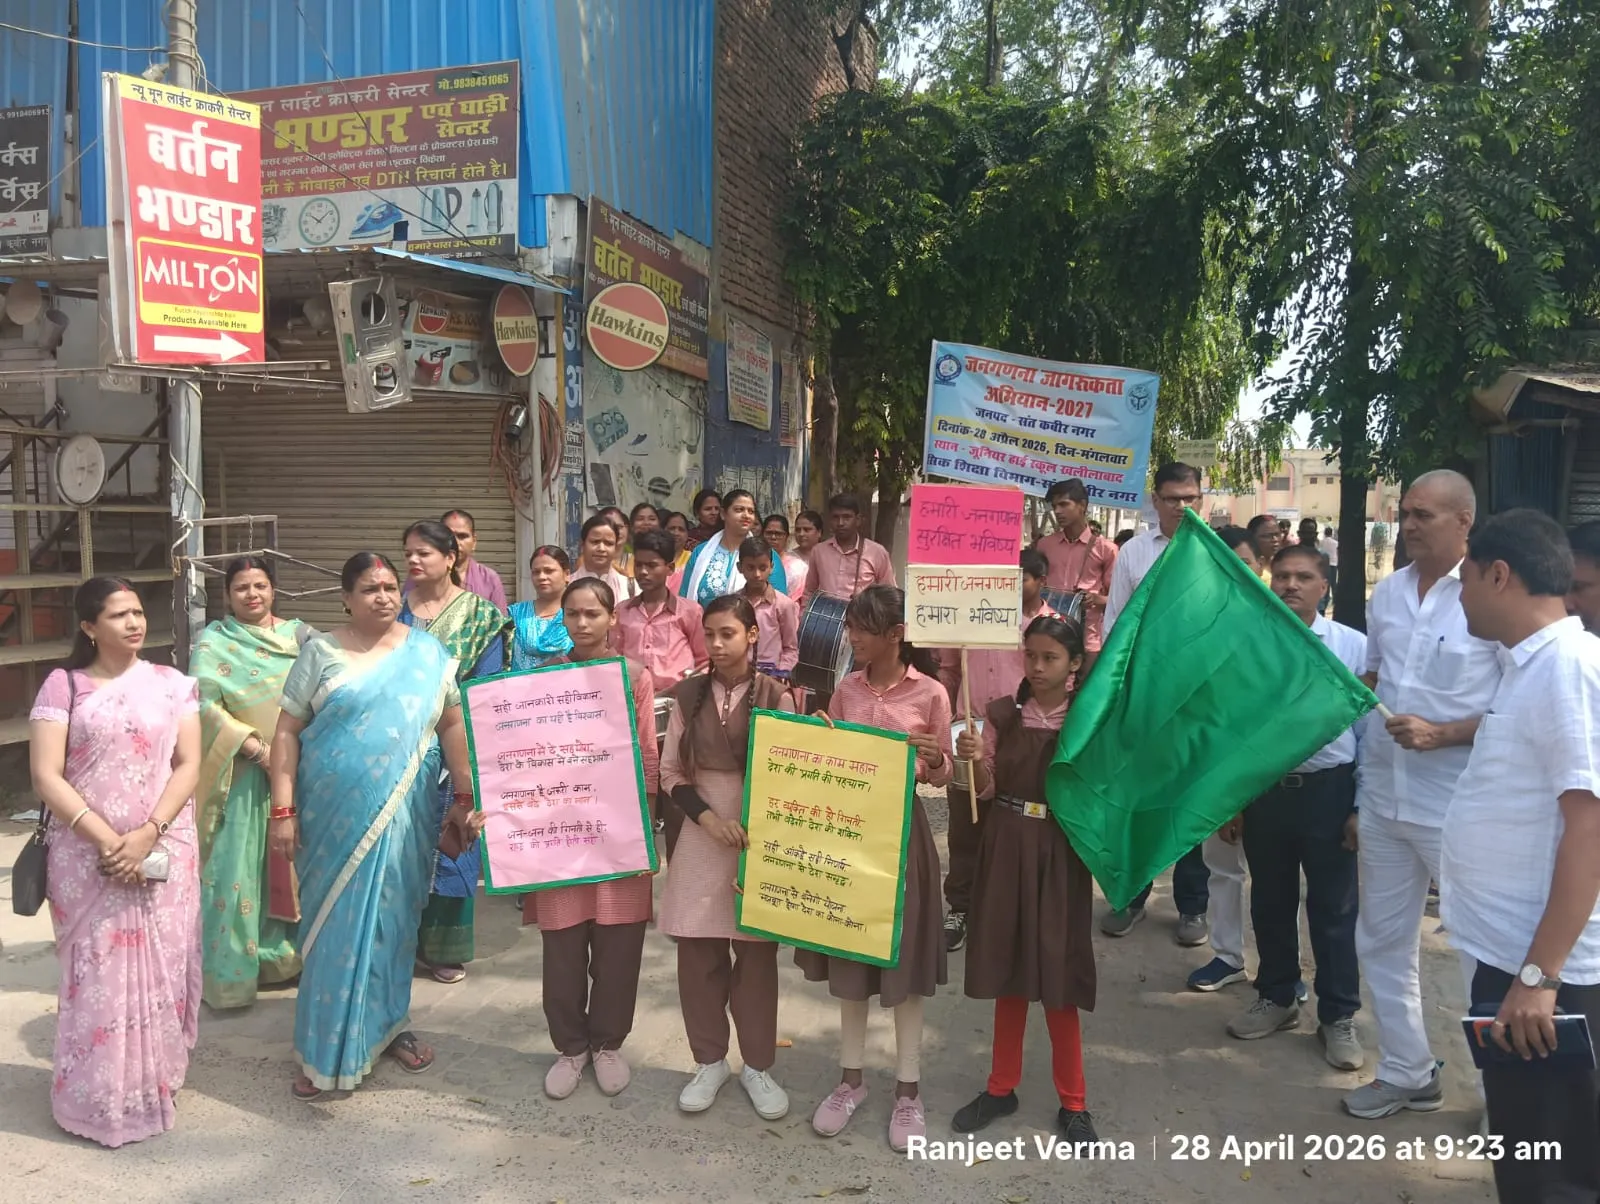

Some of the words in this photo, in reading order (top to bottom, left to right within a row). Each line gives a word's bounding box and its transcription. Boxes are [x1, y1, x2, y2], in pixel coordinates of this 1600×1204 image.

[131, 84, 145, 101] न्यू
[147, 88, 163, 104] मून
[166, 91, 192, 109] लाईट
[195, 98, 224, 115] क्राकरी
[280, 91, 323, 111] लाईट
[328, 87, 381, 107] क्राकरी
[387, 82, 431, 100] सेन्टर
[419, 97, 455, 119] एवं
[274, 105, 413, 153] भण्डार
[435, 119, 492, 138] सेन्टर
[0, 142, 39, 166] र्क्स
[145, 121, 242, 184] बर्तन
[283, 178, 295, 194] के
[416, 163, 457, 182] रिचार्ज
[462, 162, 486, 179] होते
[137, 184, 256, 245] भण्डार
[593, 235, 634, 280] बर्तन
[144, 256, 257, 300] MILTON
[163, 314, 197, 325] Products
[231, 321, 247, 329] Here
[495, 321, 537, 341] Hawkins
[590, 305, 665, 348] Hawkins
[964, 356, 1037, 383] जनगणना
[984, 384, 1093, 418] अभियान-2027
[976, 407, 1009, 422] जनपद
[1018, 414, 1037, 428] संत
[1071, 425, 1096, 438] नगर
[937, 419, 987, 439] दिनांक-28
[1021, 438, 1050, 455] 2026,
[1055, 443, 1128, 465] दिन-मंगलवार
[934, 440, 959, 452] स्थान
[968, 446, 1006, 462] जूनियर
[1008, 454, 1028, 468] हाई
[1030, 459, 1057, 475] स्कूल
[1060, 466, 1124, 483] खलीलाबाद
[954, 458, 992, 476] शिक्षा
[1108, 490, 1138, 502] नगर
[919, 496, 960, 519] हमारी
[961, 508, 1021, 526] जनगणना
[916, 525, 968, 551] सुरक्षित
[970, 529, 1017, 556] भविष्य
[914, 568, 963, 595] हमारी
[961, 576, 1018, 592] जनगणना
[914, 603, 960, 628] हमारा
[492, 699, 512, 714] सही
[515, 693, 555, 710] जानकारी
[557, 690, 572, 705] सही
[536, 715, 547, 725] का
[565, 709, 574, 723] है
[515, 758, 525, 769] के
[527, 757, 555, 769] विकास
[769, 745, 812, 763] जनगणना
[811, 753, 826, 764] का
[825, 755, 848, 769] काम
[848, 760, 879, 776] महान
[784, 762, 798, 777] की
[800, 768, 821, 781] प्रगति
[821, 770, 834, 785] की
[500, 789, 537, 800] जनगणना
[536, 783, 545, 797] है
[767, 796, 781, 809] हर
[782, 799, 809, 815] व्यक्ति
[809, 805, 823, 818] की
[507, 827, 545, 840] जन-जन
[547, 821, 558, 835] की
[560, 820, 583, 834] गिनती
[583, 821, 593, 833] से
[766, 809, 783, 822] तभी
[824, 822, 836, 834] की
[763, 839, 781, 855] सही
[797, 861, 807, 873] से
[790, 885, 799, 899] से
[815, 910, 825, 920] का
